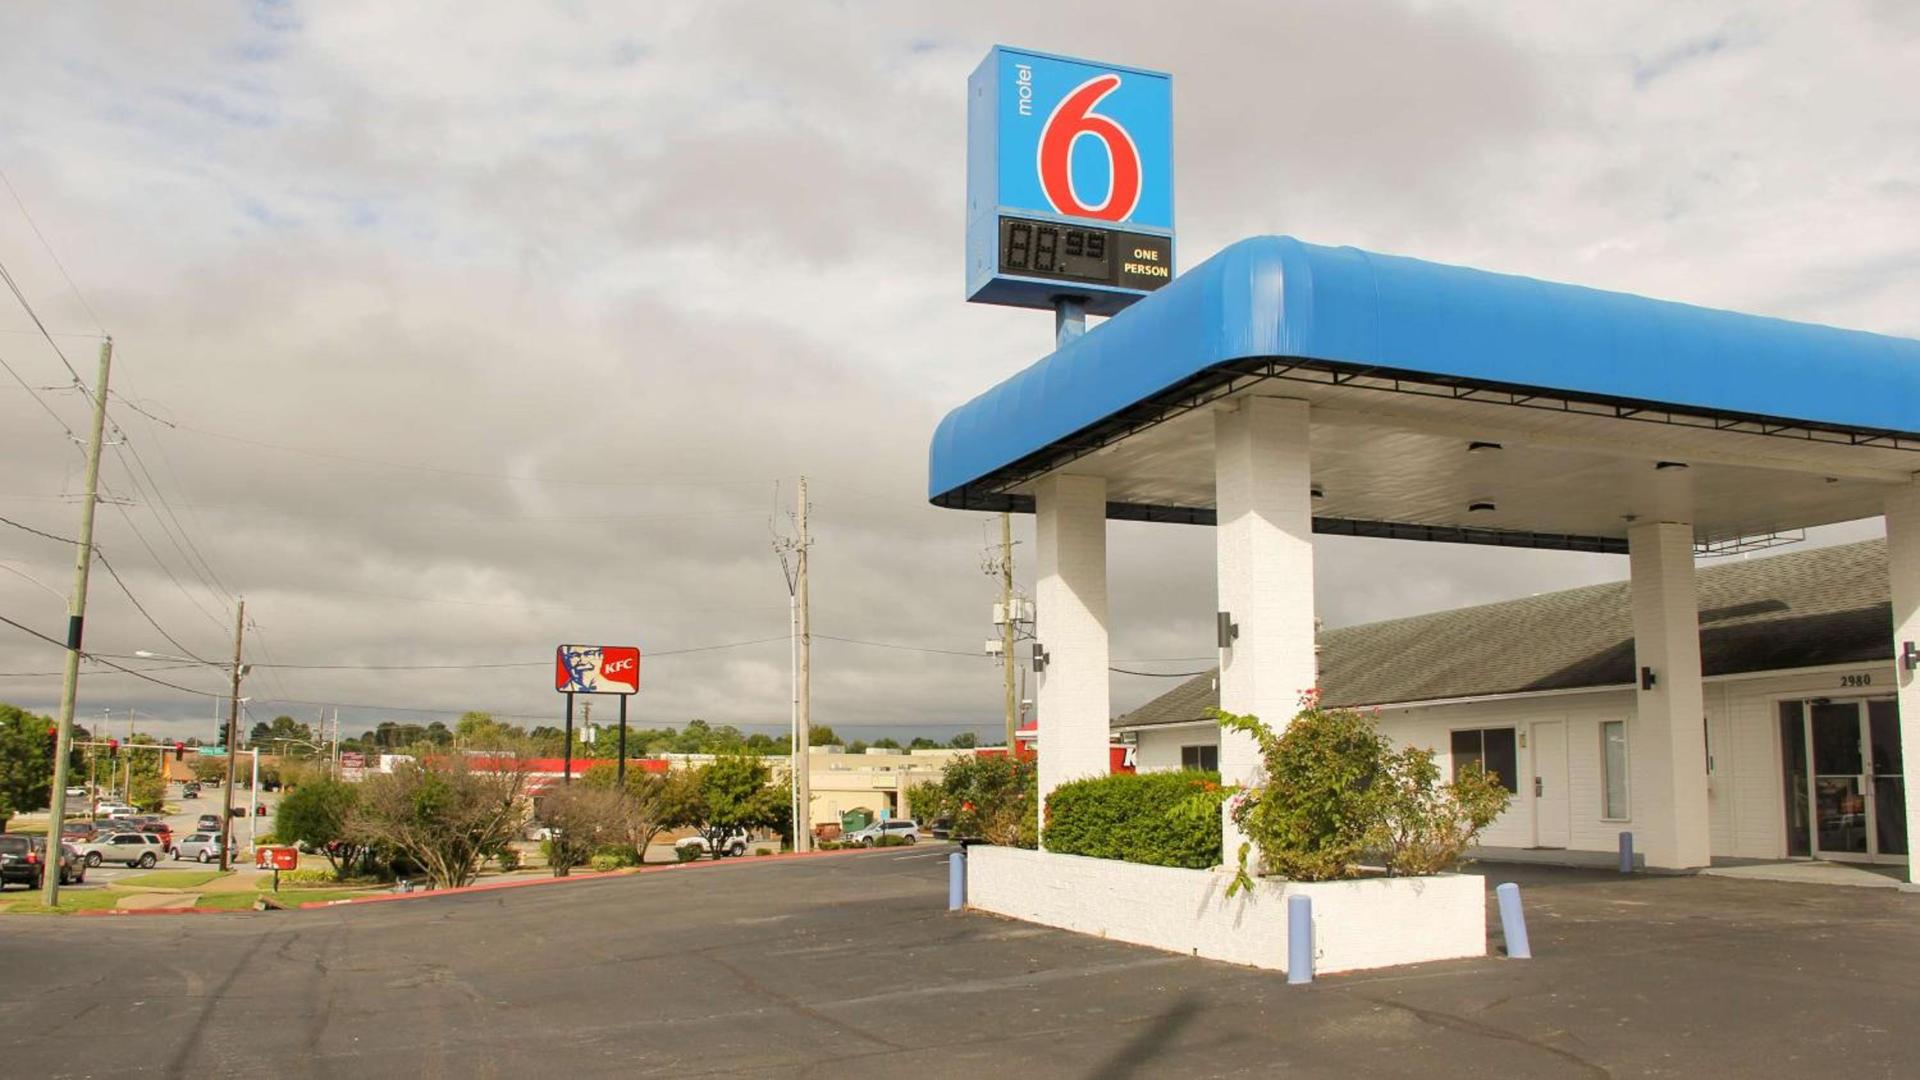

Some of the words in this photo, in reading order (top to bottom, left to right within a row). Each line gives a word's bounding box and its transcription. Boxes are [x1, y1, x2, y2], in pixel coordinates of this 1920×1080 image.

[1015, 64, 1032, 116] motel
[1037, 74, 1142, 222] 6
[1134, 249, 1158, 261] ONE
[1124, 263, 1168, 277] PERSON
[605, 658, 633, 673] KFC
[1841, 674, 1871, 687] 2980
